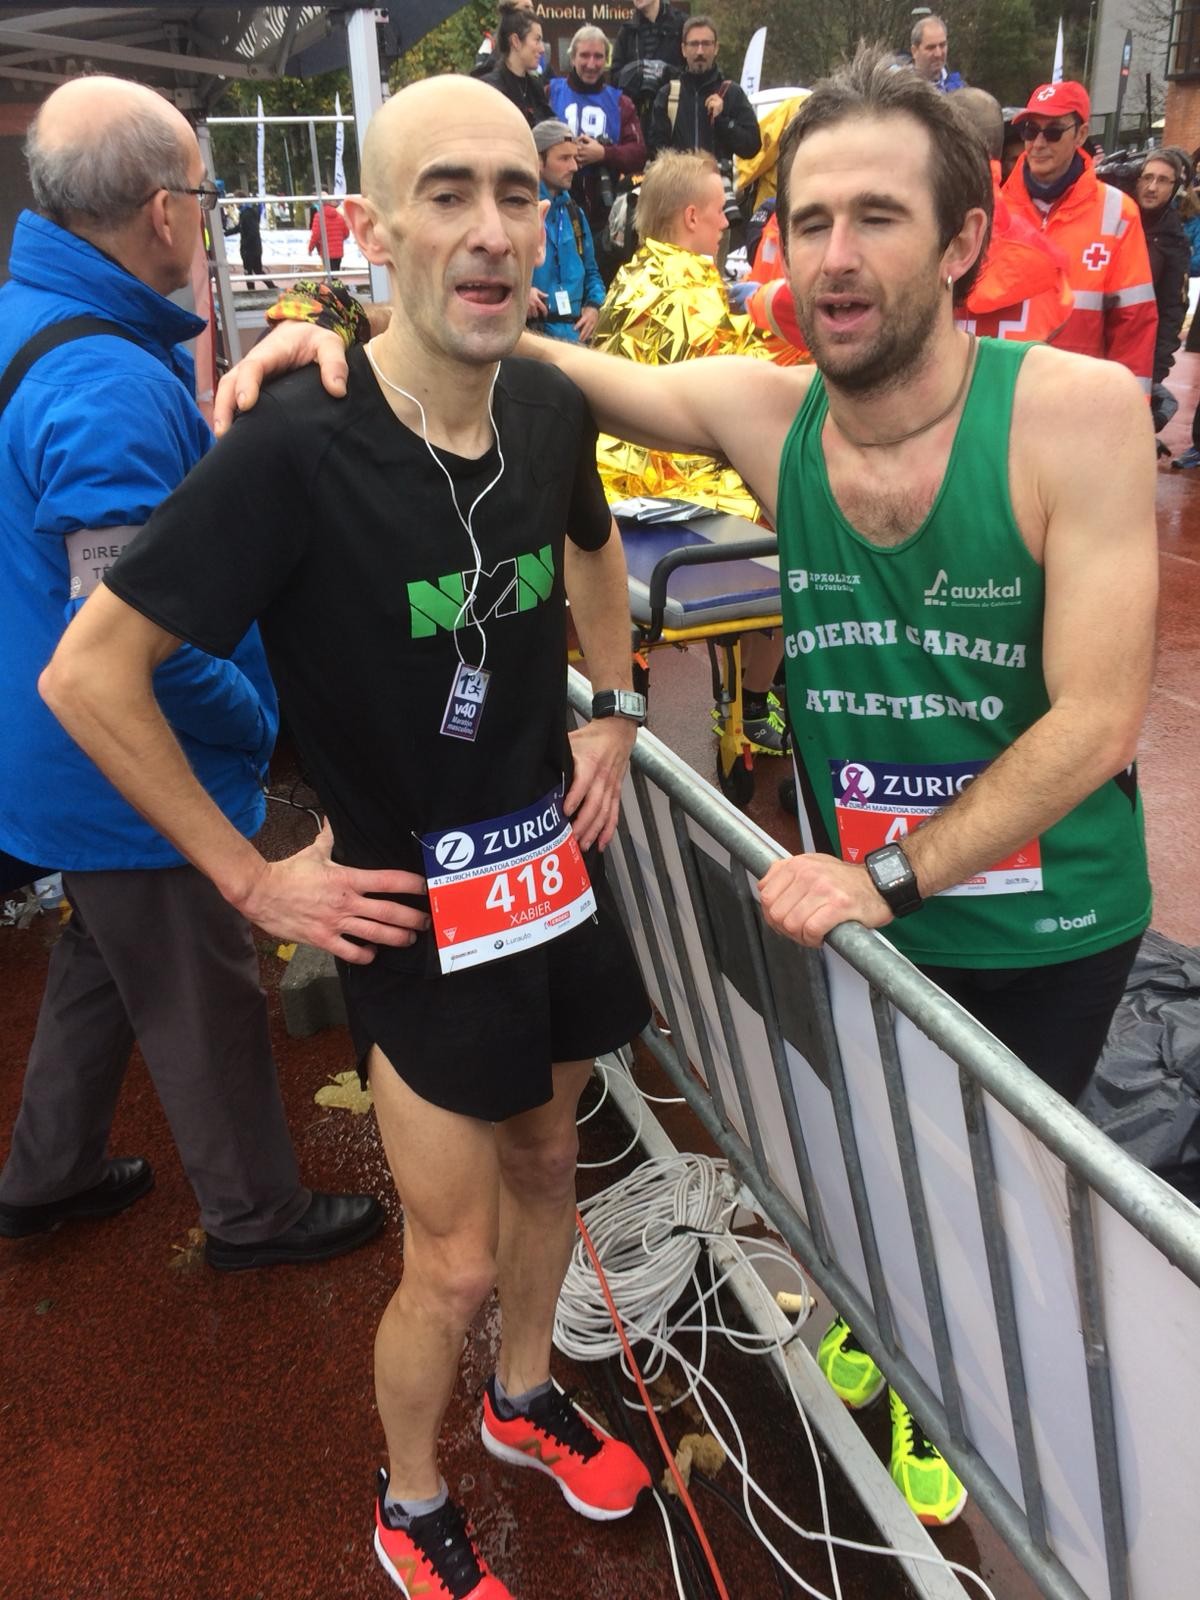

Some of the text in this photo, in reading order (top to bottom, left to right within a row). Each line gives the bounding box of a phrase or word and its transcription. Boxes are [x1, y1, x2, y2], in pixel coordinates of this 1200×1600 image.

[536, 3, 586, 19] Anoeta
[82, 545, 127, 561] DIRE
[950, 576, 1021, 599] auxkal
[785, 619, 1027, 669] GOIERRI GARAIA
[454, 702, 477, 719] v40
[805, 688, 1005, 722] ATLETISMO
[883, 774, 976, 798] ZURIC
[482, 803, 561, 856] ZURICH
[444, 871, 472, 884] ZURICH
[472, 862, 510, 877] MARATOIA
[485, 853, 564, 914] 418
[509, 900, 552, 927] XABIER
[505, 931, 532, 946] Lurauto
